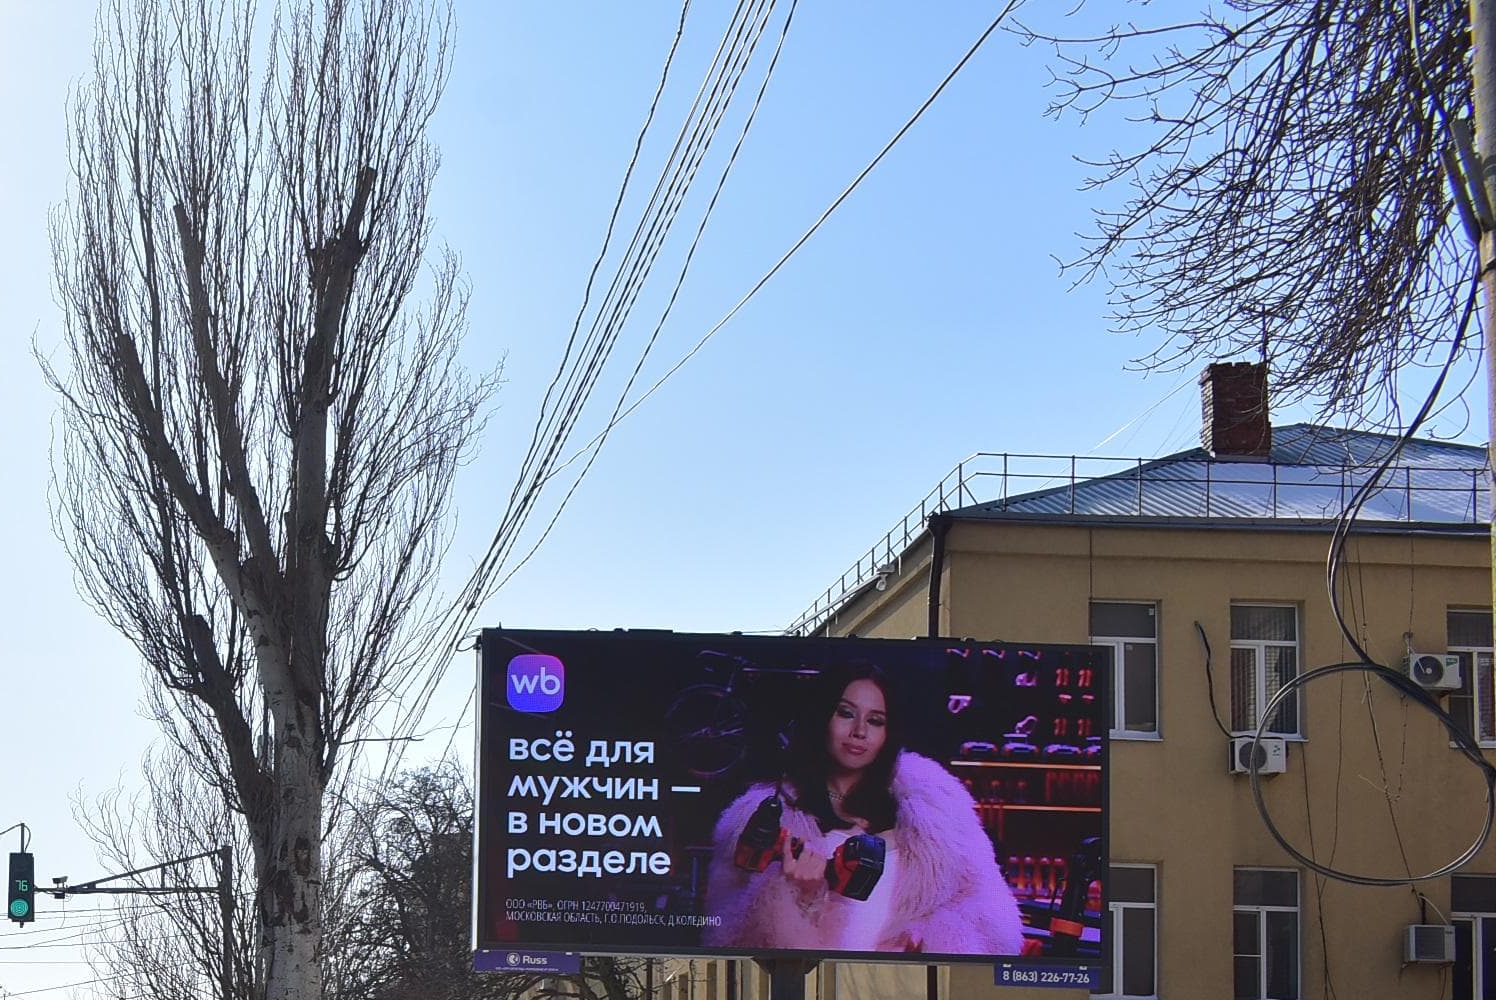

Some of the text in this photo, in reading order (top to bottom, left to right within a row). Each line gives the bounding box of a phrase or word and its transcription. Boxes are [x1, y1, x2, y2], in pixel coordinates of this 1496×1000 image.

[510, 666, 561, 695] wb
[509, 730, 655, 768] всё для
[507, 774, 659, 806] мужчин
[507, 811, 663, 838] в новом
[507, 847, 672, 879] разделе
[505, 898, 526, 910] ООО
[556, 900, 579, 911] ОГРН
[505, 911, 562, 922] МОСКОВСКАЯ
[522, 955, 548, 965] Russ
[1002, 969, 1090, 984] 8 (863) 226-77-26
